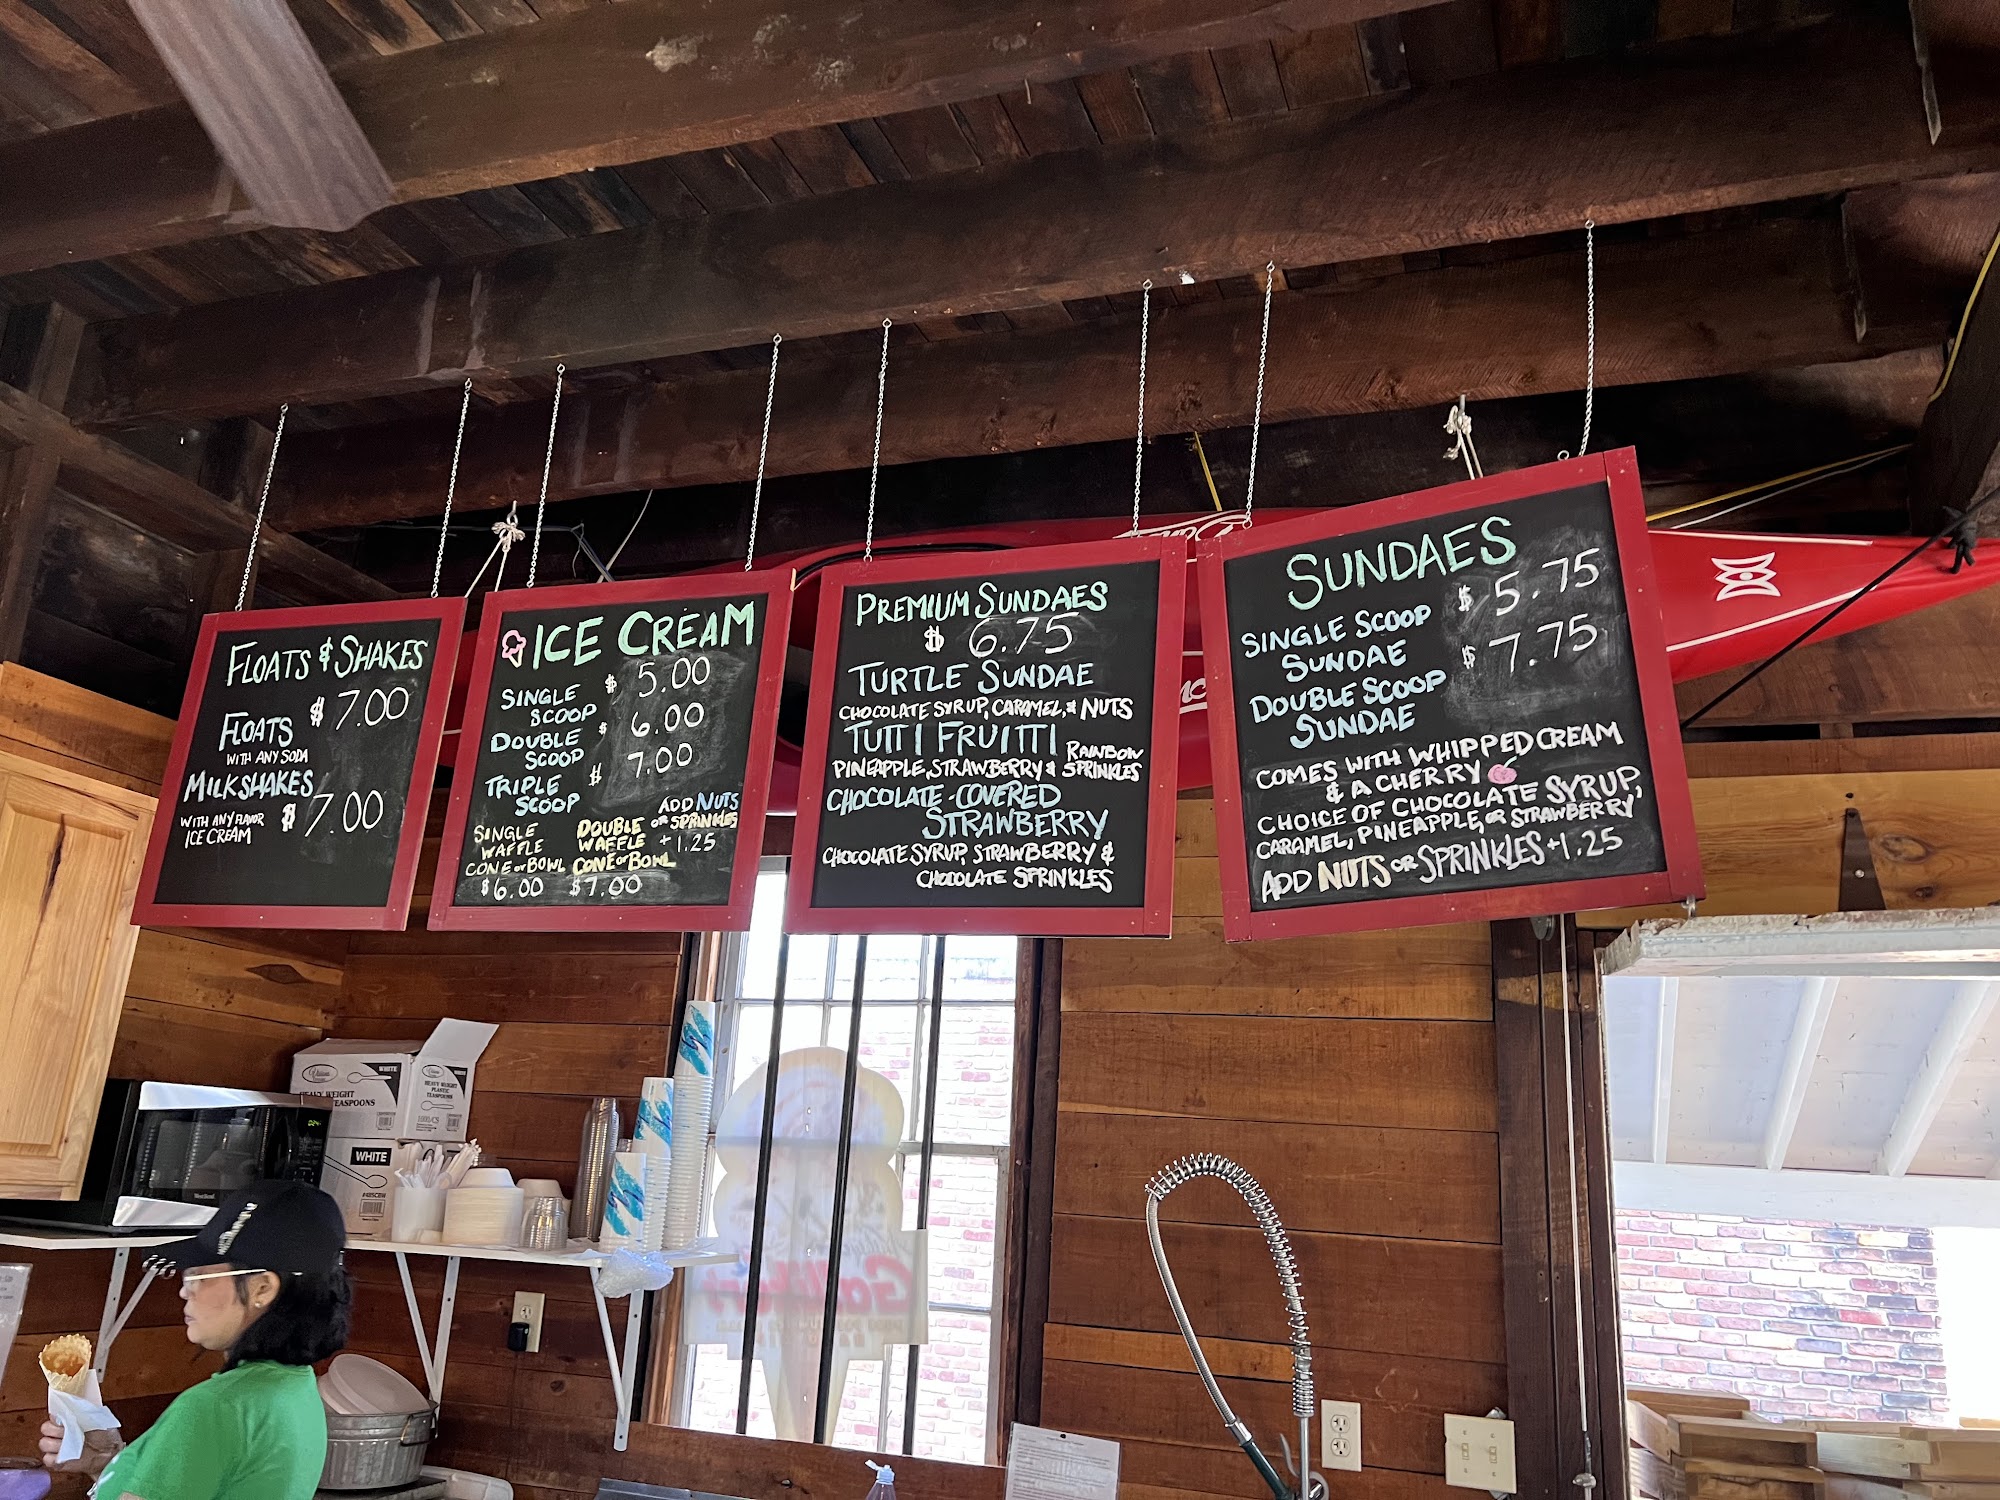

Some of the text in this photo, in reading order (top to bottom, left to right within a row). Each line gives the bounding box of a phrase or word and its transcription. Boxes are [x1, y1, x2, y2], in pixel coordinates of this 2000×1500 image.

[1286, 515, 1518, 611] SUNDAES
[1458, 547, 1601, 617] $ 5.75
[855, 580, 1109, 627] PREMIUM SUNDAES
[533, 601, 755, 670] ICE CREAM
[923, 611, 1080, 659] $ 6.75
[1240, 604, 1433, 660] SINGLE SCOOP
[1461, 612, 1599, 675] $ 7.75
[226, 635, 429, 686] FLOATS & SHAKES
[1280, 639, 1408, 684] SUNDAE
[604, 656, 711, 699] $ 5.00
[848, 659, 1094, 697] TURTLE SUNDAE
[310, 686, 410, 730] $ 7.00
[501, 683, 581, 710] SINGLE
[838, 699, 930, 722] CHOCOLATE
[933, 697, 989, 721] SYRUP,
[991, 698, 1065, 719] CARAMEL,
[1080, 697, 1134, 721] NUTS
[1249, 682, 1356, 724] DOUBLE
[1361, 668, 1447, 704] SCOOP
[218, 711, 293, 751] FLOATS
[530, 703, 597, 727] SCOOP
[598, 702, 705, 737] $ 6.00
[1289, 702, 1417, 749] SUNDAE
[491, 728, 582, 753] DOUBLE
[843, 720, 1058, 756] TUTTI FRUITTI
[1066, 740, 1145, 762] RAINBOW
[226, 749, 308, 766] WITH ANY SODA
[525, 749, 585, 770] SCOOP
[588, 742, 693, 787] $ 7.00
[832, 758, 1143, 783] PINEAPPLE, STRAWBERRY & SPRINKLES
[1255, 721, 1624, 790] COMES WITH WHIPPED CREAM
[183, 769, 314, 802] MILKSHAKES
[485, 773, 562, 799] TRIPLE
[1325, 759, 1481, 805] & A CHERRY
[281, 789, 384, 837] $ 7.00
[514, 792, 580, 817] SCOOP
[658, 792, 739, 814] ADD NUTS
[1257, 765, 1644, 835] CHOICE OF CHOCOLATE SYRUP,
[180, 812, 265, 828] WITH ANY FLAVOR
[473, 822, 539, 844] SINGLE
[576, 816, 645, 840] DOUBLE
[669, 811, 738, 831] SPRINKLES
[921, 807, 1110, 840] STRAWBERRY
[1256, 833, 1355, 861] CARAMEL,
[1357, 811, 1485, 845] PINEAPPLE,
[1510, 794, 1637, 829] STRAWBERRY
[185, 827, 251, 848] ICE CREAM
[481, 838, 544, 860] WAFFLE
[577, 833, 646, 853] WAFFLE
[821, 840, 1116, 867] CHOCOLATE SYRUP, STRAWBERRY &
[465, 860, 512, 878] CONE
[526, 856, 567, 875] BOWL
[572, 852, 616, 876] CONE
[627, 851, 677, 871] BOWL
[916, 866, 1114, 894] CHOCOLATE SPRINKLES
[1259, 869, 1313, 903] ADD
[1316, 854, 1392, 891] NUTS
[1417, 829, 1546, 883] SPRINKLES
[378, 1065, 398, 1073] WHITE
[325, 1090, 354, 1098] WEIGHT
[355, 1150, 387, 1163] WHITE
